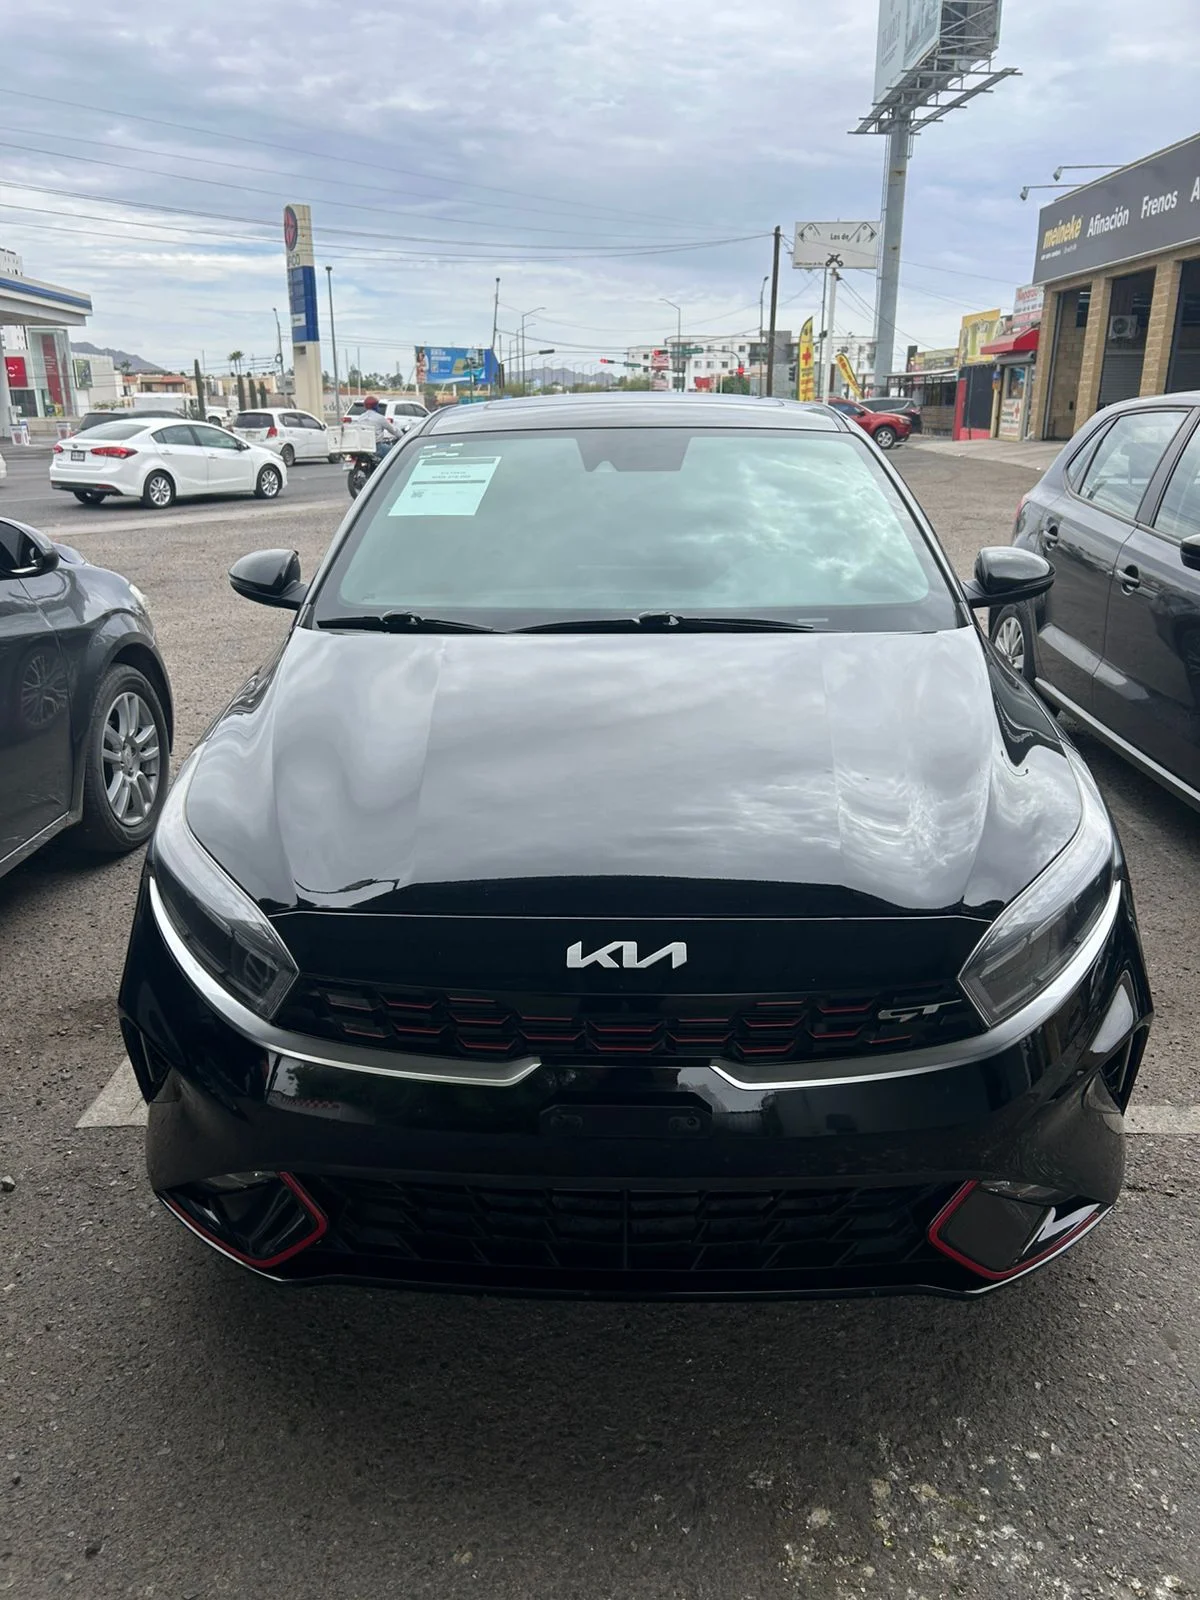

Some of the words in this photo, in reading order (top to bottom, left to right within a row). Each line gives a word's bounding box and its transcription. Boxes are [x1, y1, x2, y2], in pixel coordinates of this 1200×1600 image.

[1043, 215, 1082, 250] meineke
[1087, 205, 1130, 238] Afinación
[1141, 190, 1178, 219] Frenos
[566, 941, 688, 969] KIA
[878, 999, 963, 1023] GT
